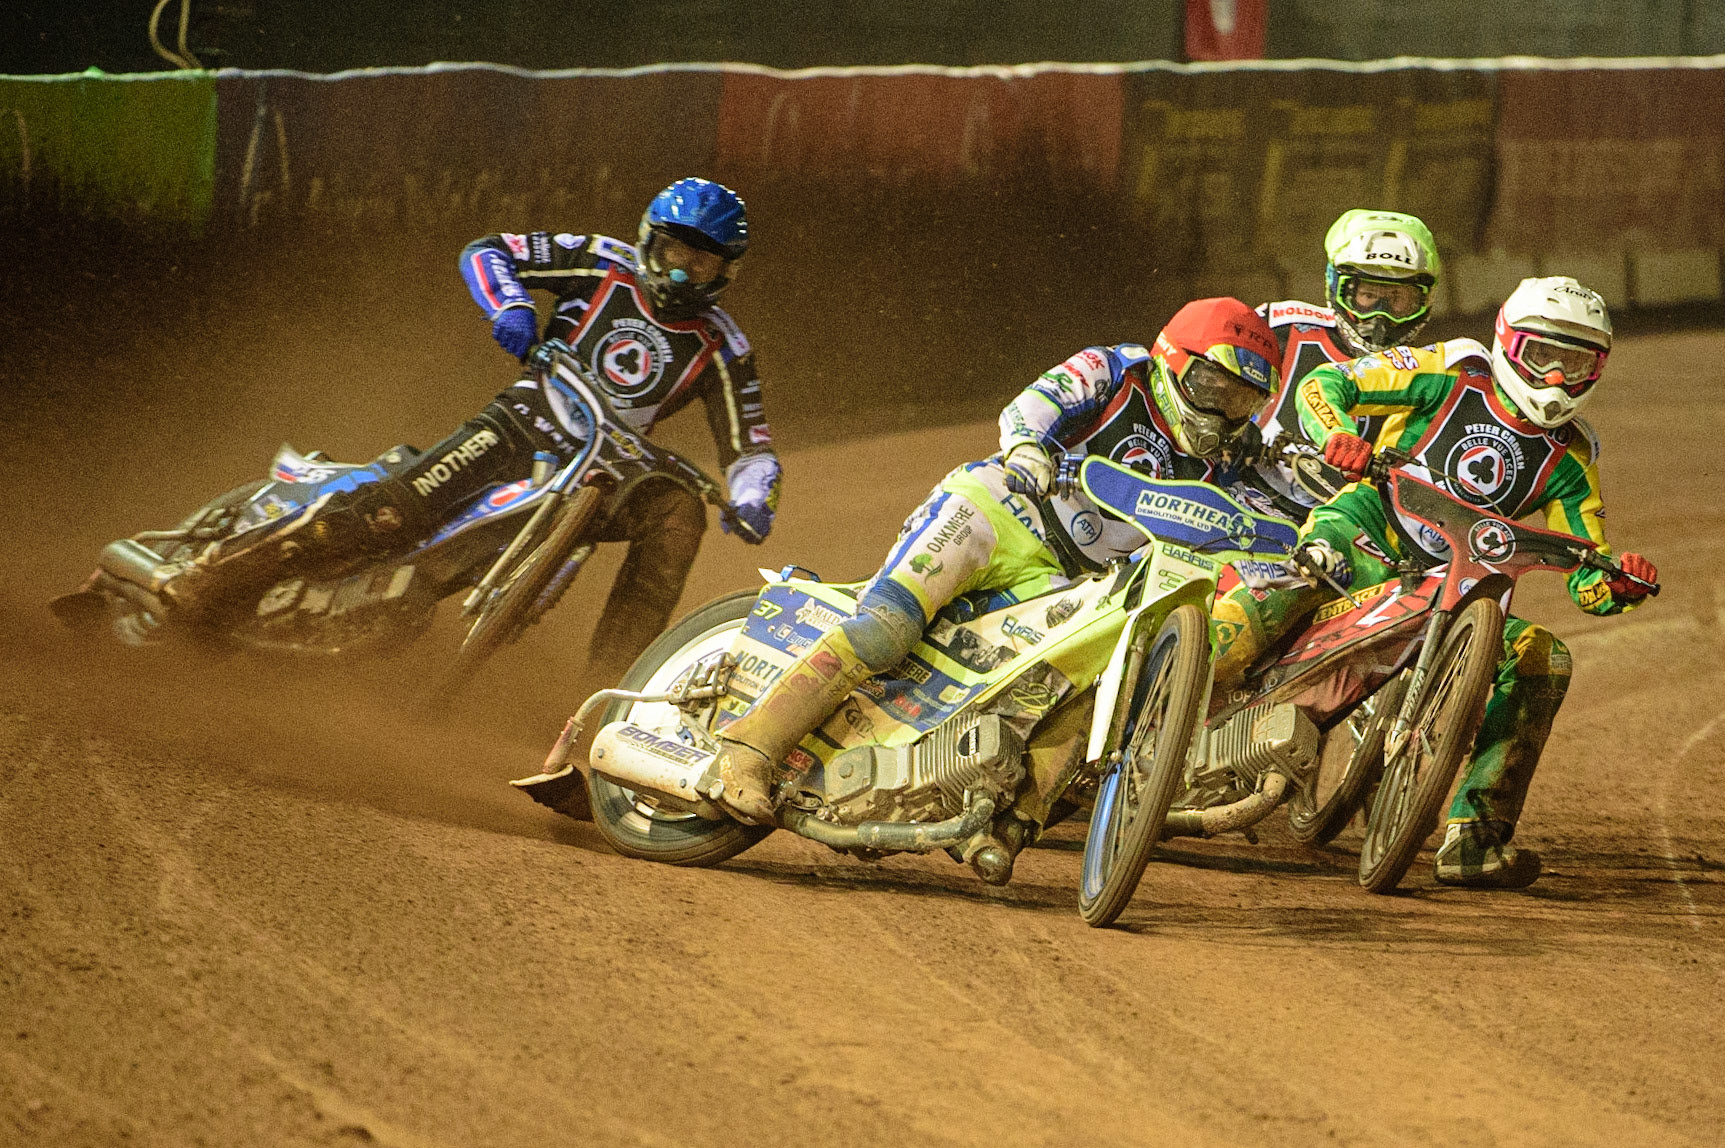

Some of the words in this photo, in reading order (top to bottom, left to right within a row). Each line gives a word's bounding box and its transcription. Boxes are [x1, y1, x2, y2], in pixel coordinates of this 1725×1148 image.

[1133, 423, 1157, 442] PETER
[1461, 438, 1489, 451] BELLE
[1492, 440, 1508, 456] VUE
[1464, 423, 1501, 435] PETER
[1501, 430, 1526, 470] CRAVEN
[926, 505, 975, 554] OAKMERE
[1137, 507, 1182, 521] DEMOLITION
[1184, 517, 1195, 526] UK
[1196, 521, 1210, 532] LTD
[952, 525, 973, 547] GROUP
[1162, 543, 1215, 572] HARRIS
[752, 599, 784, 621] 37
[617, 726, 711, 762] BOMBER
